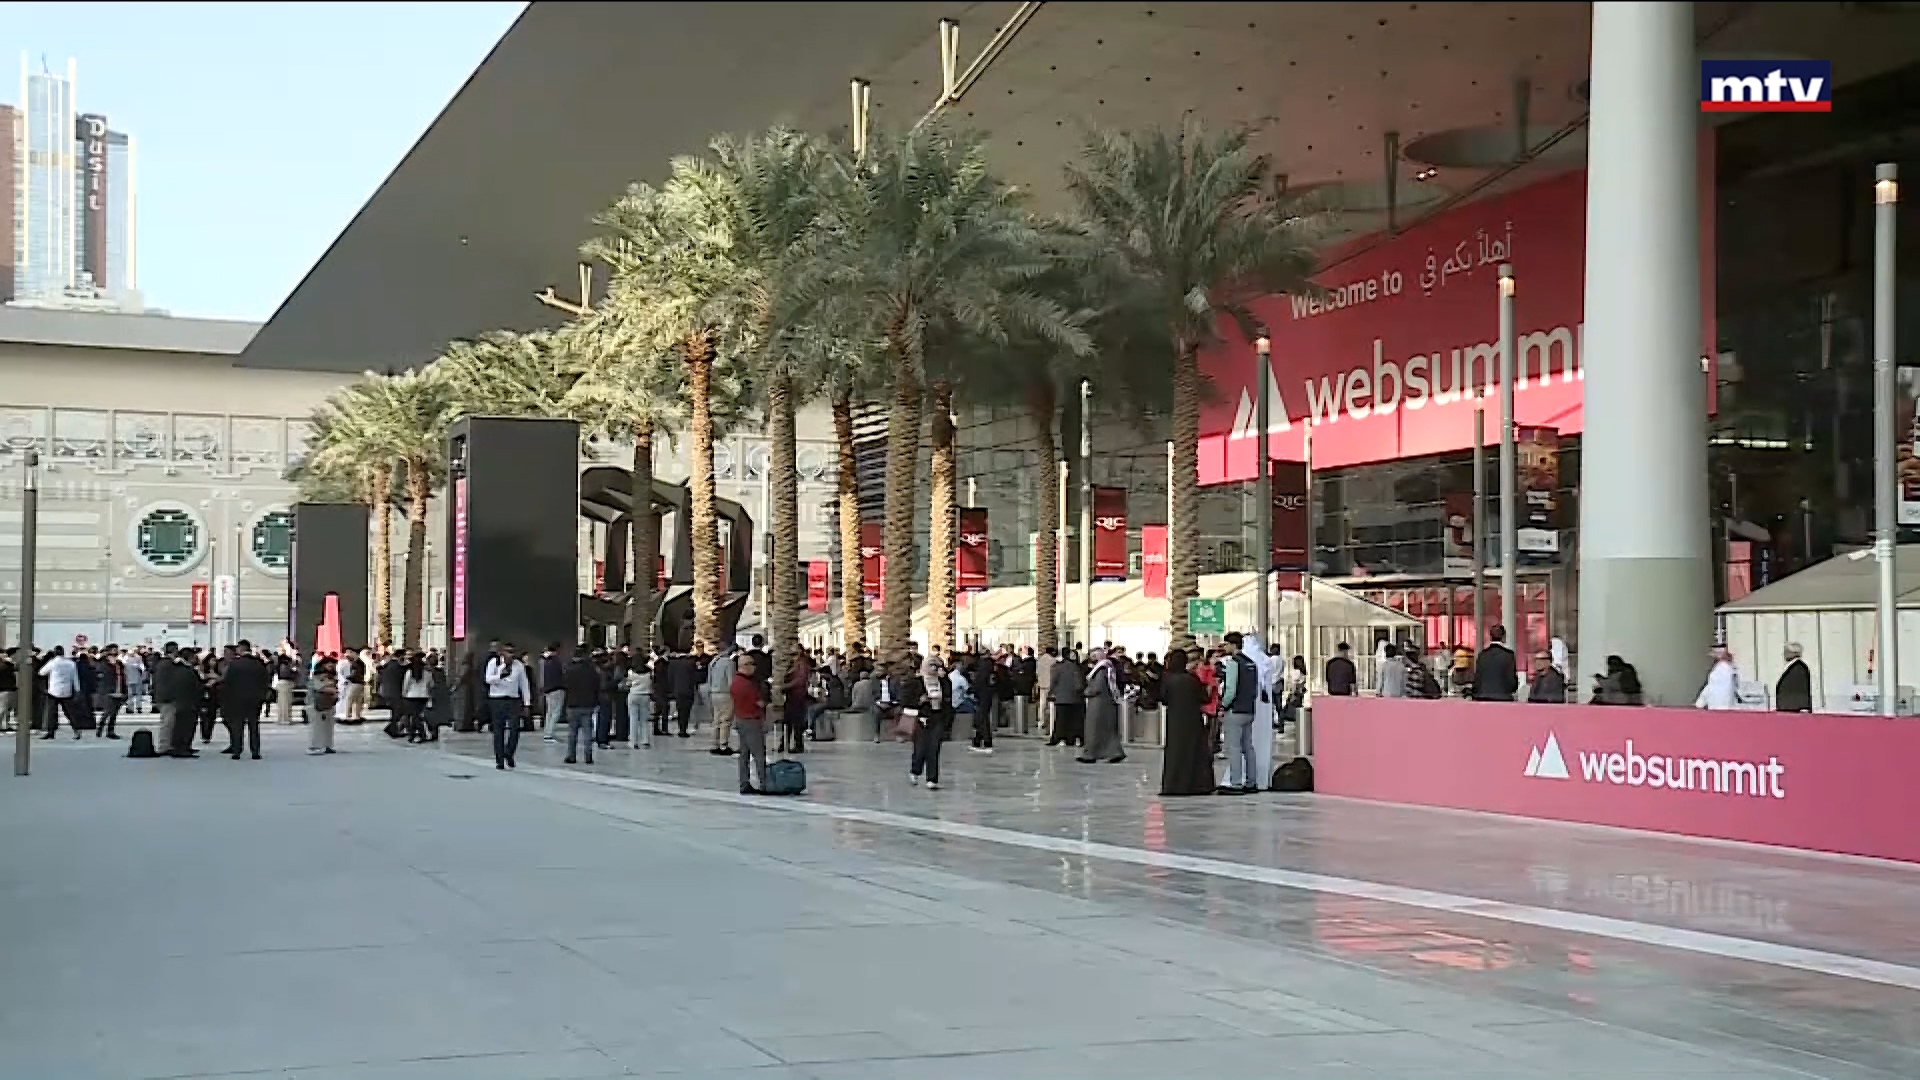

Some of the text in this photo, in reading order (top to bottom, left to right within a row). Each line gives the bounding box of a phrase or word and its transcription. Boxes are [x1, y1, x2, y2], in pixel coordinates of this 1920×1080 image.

[1418, 245, 1438, 297] في
[1441, 239, 1474, 287] بكم
[1291, 269, 1404, 320] Welcome to
[1580, 738, 1786, 799] websummit
